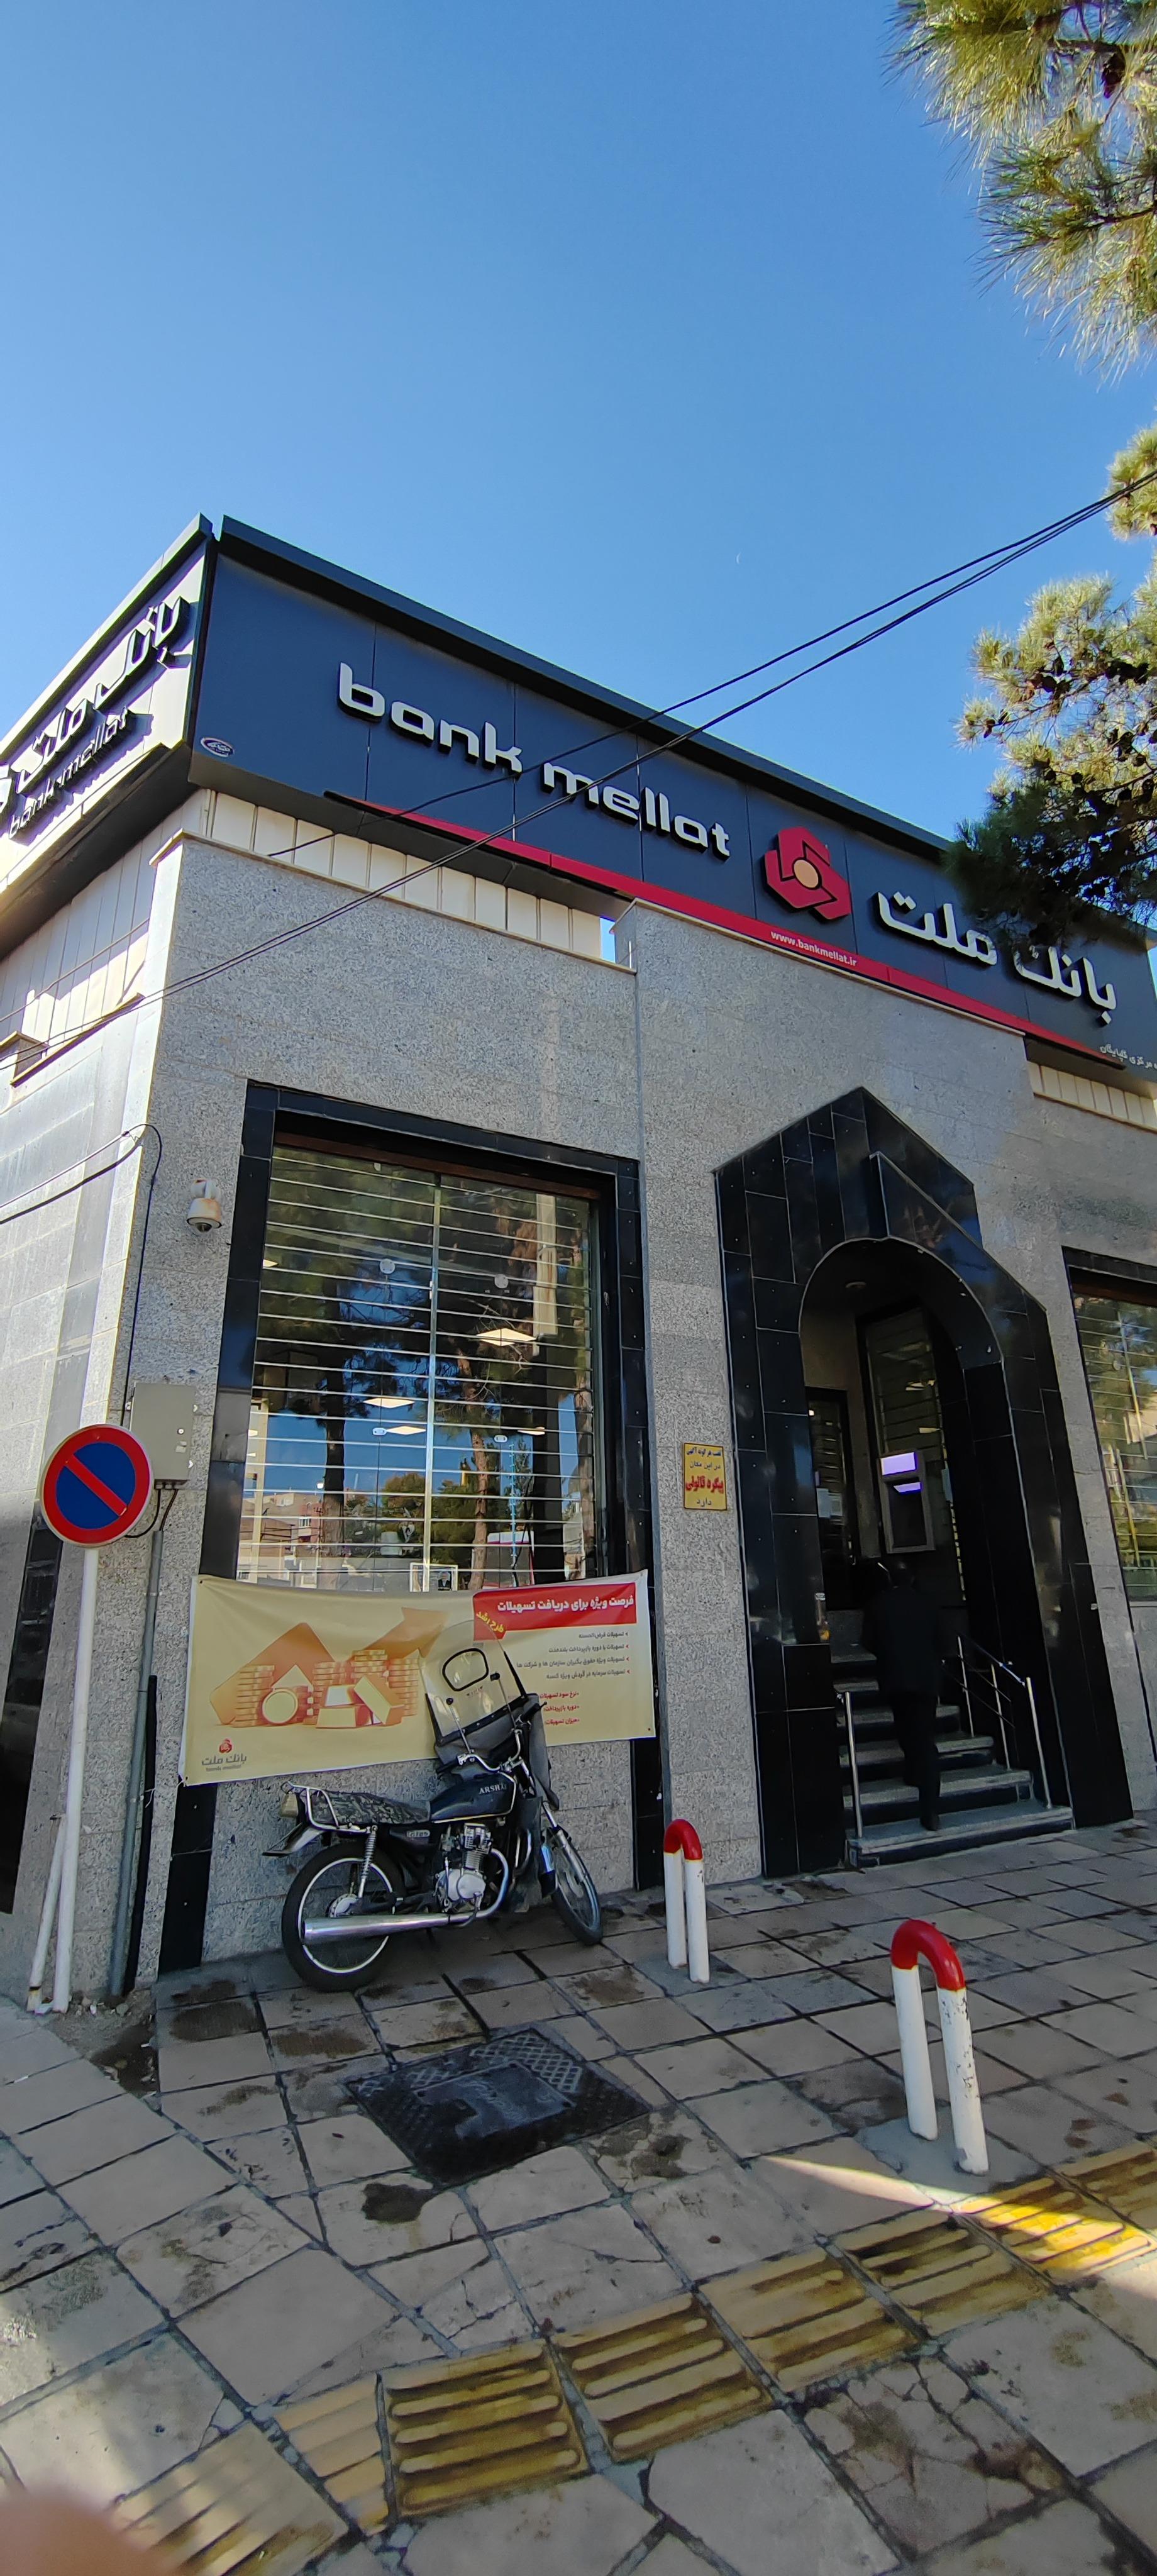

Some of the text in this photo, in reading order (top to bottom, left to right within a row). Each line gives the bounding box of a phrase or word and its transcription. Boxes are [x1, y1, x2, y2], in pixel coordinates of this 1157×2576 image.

[16, 697, 89, 794] ملت
[339, 662, 730, 858] bank mellat
[9, 706, 128, 839] bank mellat
[878, 891, 998, 966] ملت
[770, 931, 858, 967] www.bankmellat.ir
[1100, 1044, 1127, 1063] گلپایگان
[696, 1497, 712, 1507] دارد
[497, 1595, 634, 1614] فرصت ویژه برای دریافت تسهیلات
[476, 1611, 504, 1633] طرح رشد
[201, 1755, 223, 1766] ملت
